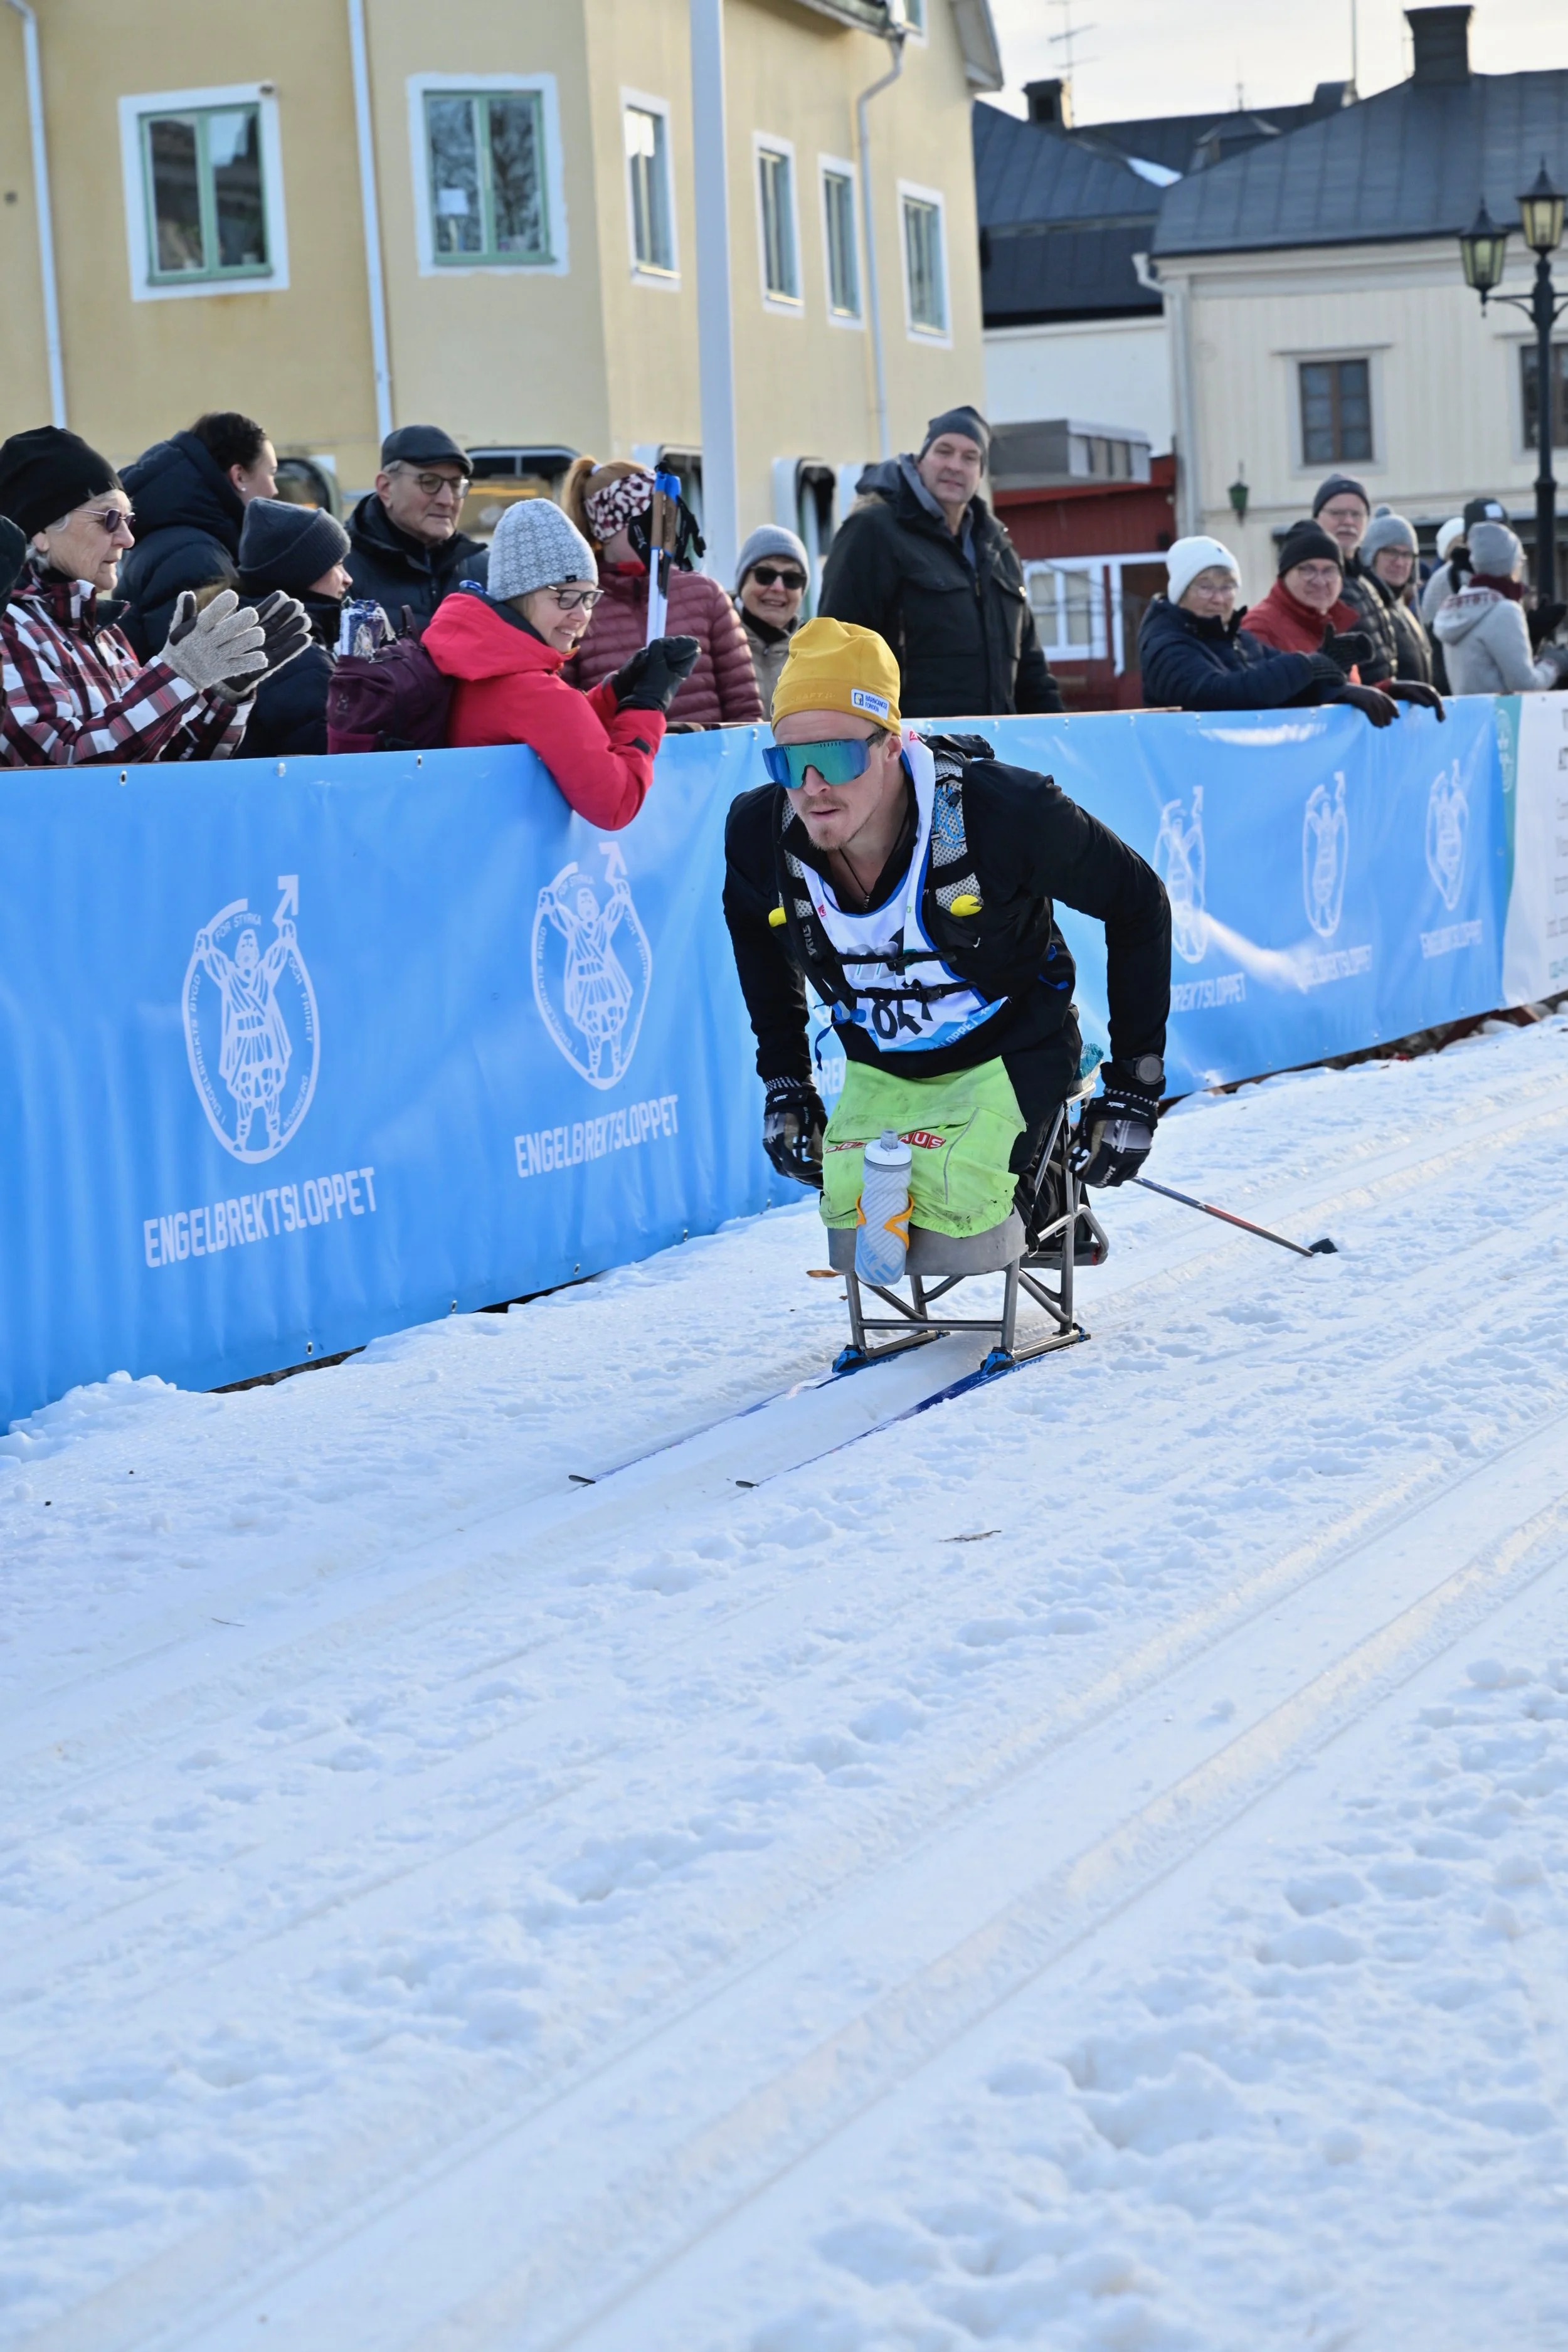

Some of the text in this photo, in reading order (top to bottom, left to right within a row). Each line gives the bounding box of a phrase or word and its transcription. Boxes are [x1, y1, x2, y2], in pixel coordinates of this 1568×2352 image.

[289, 956, 302, 985] OCH
[514, 1094, 679, 1179] ENGELBREKTSLOPPET
[143, 1166, 378, 1269] ENGELBREKTSLOPPET
